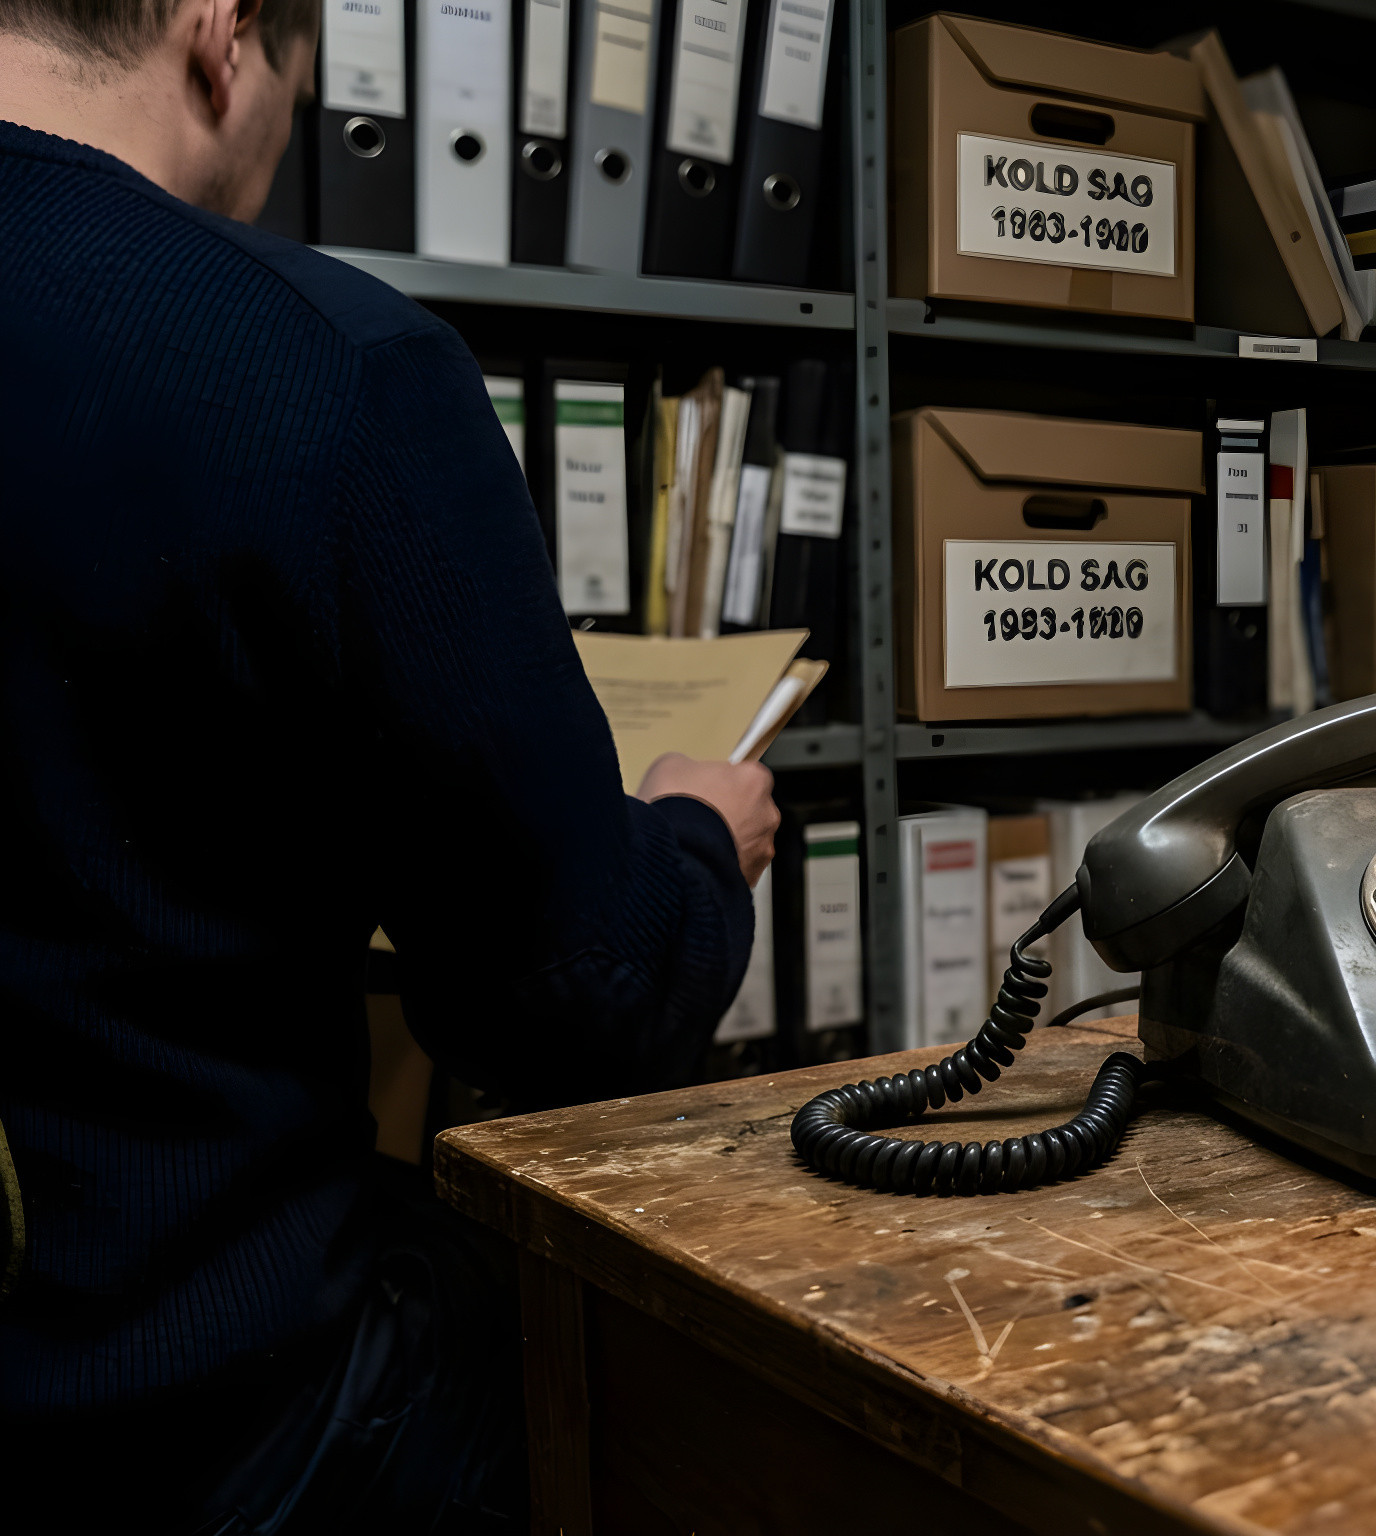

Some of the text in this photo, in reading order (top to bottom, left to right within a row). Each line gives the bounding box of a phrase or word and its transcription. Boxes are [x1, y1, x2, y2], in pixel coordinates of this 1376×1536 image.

[984, 155, 1079, 196] KOLD
[974, 558, 1149, 592] KOLD SAG
